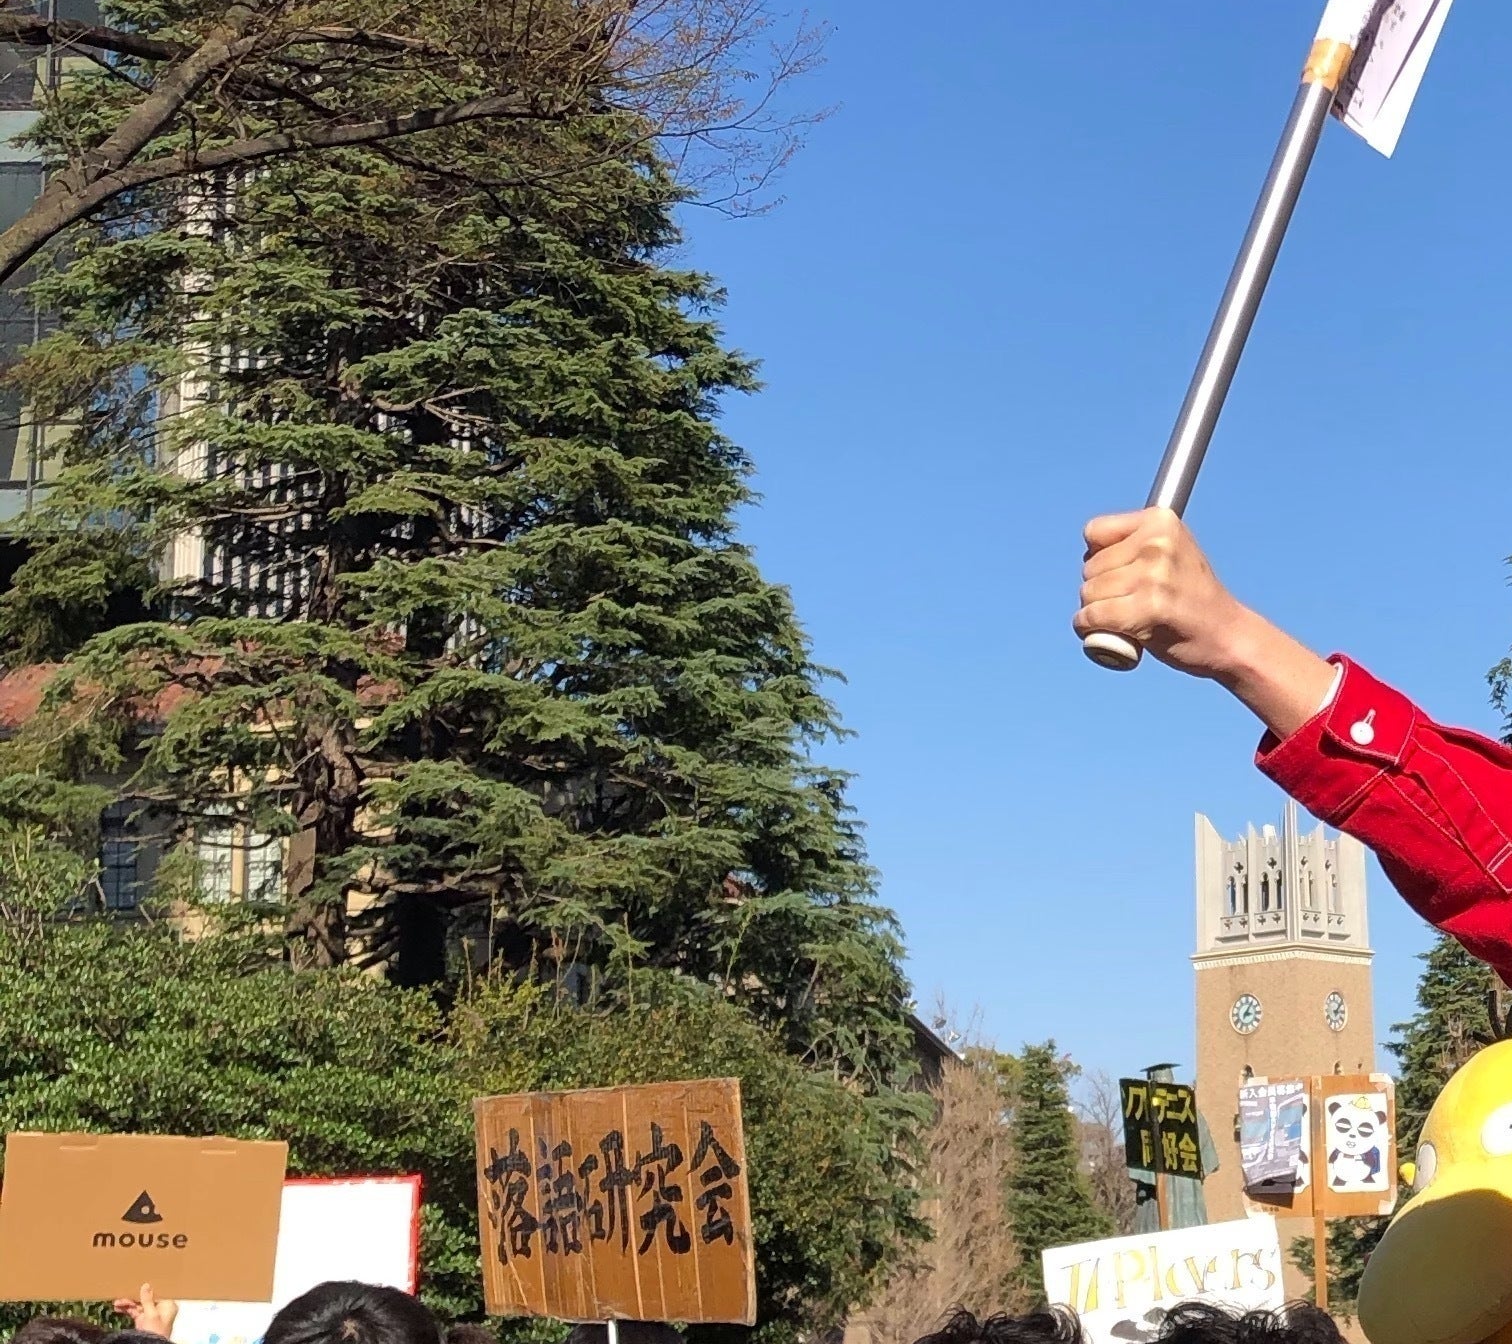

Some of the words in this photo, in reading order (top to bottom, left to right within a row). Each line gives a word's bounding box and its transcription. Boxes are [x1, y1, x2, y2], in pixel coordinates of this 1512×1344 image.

[484, 1120, 741, 1266] 落語研究会
[92, 1232, 188, 1249] mouse
